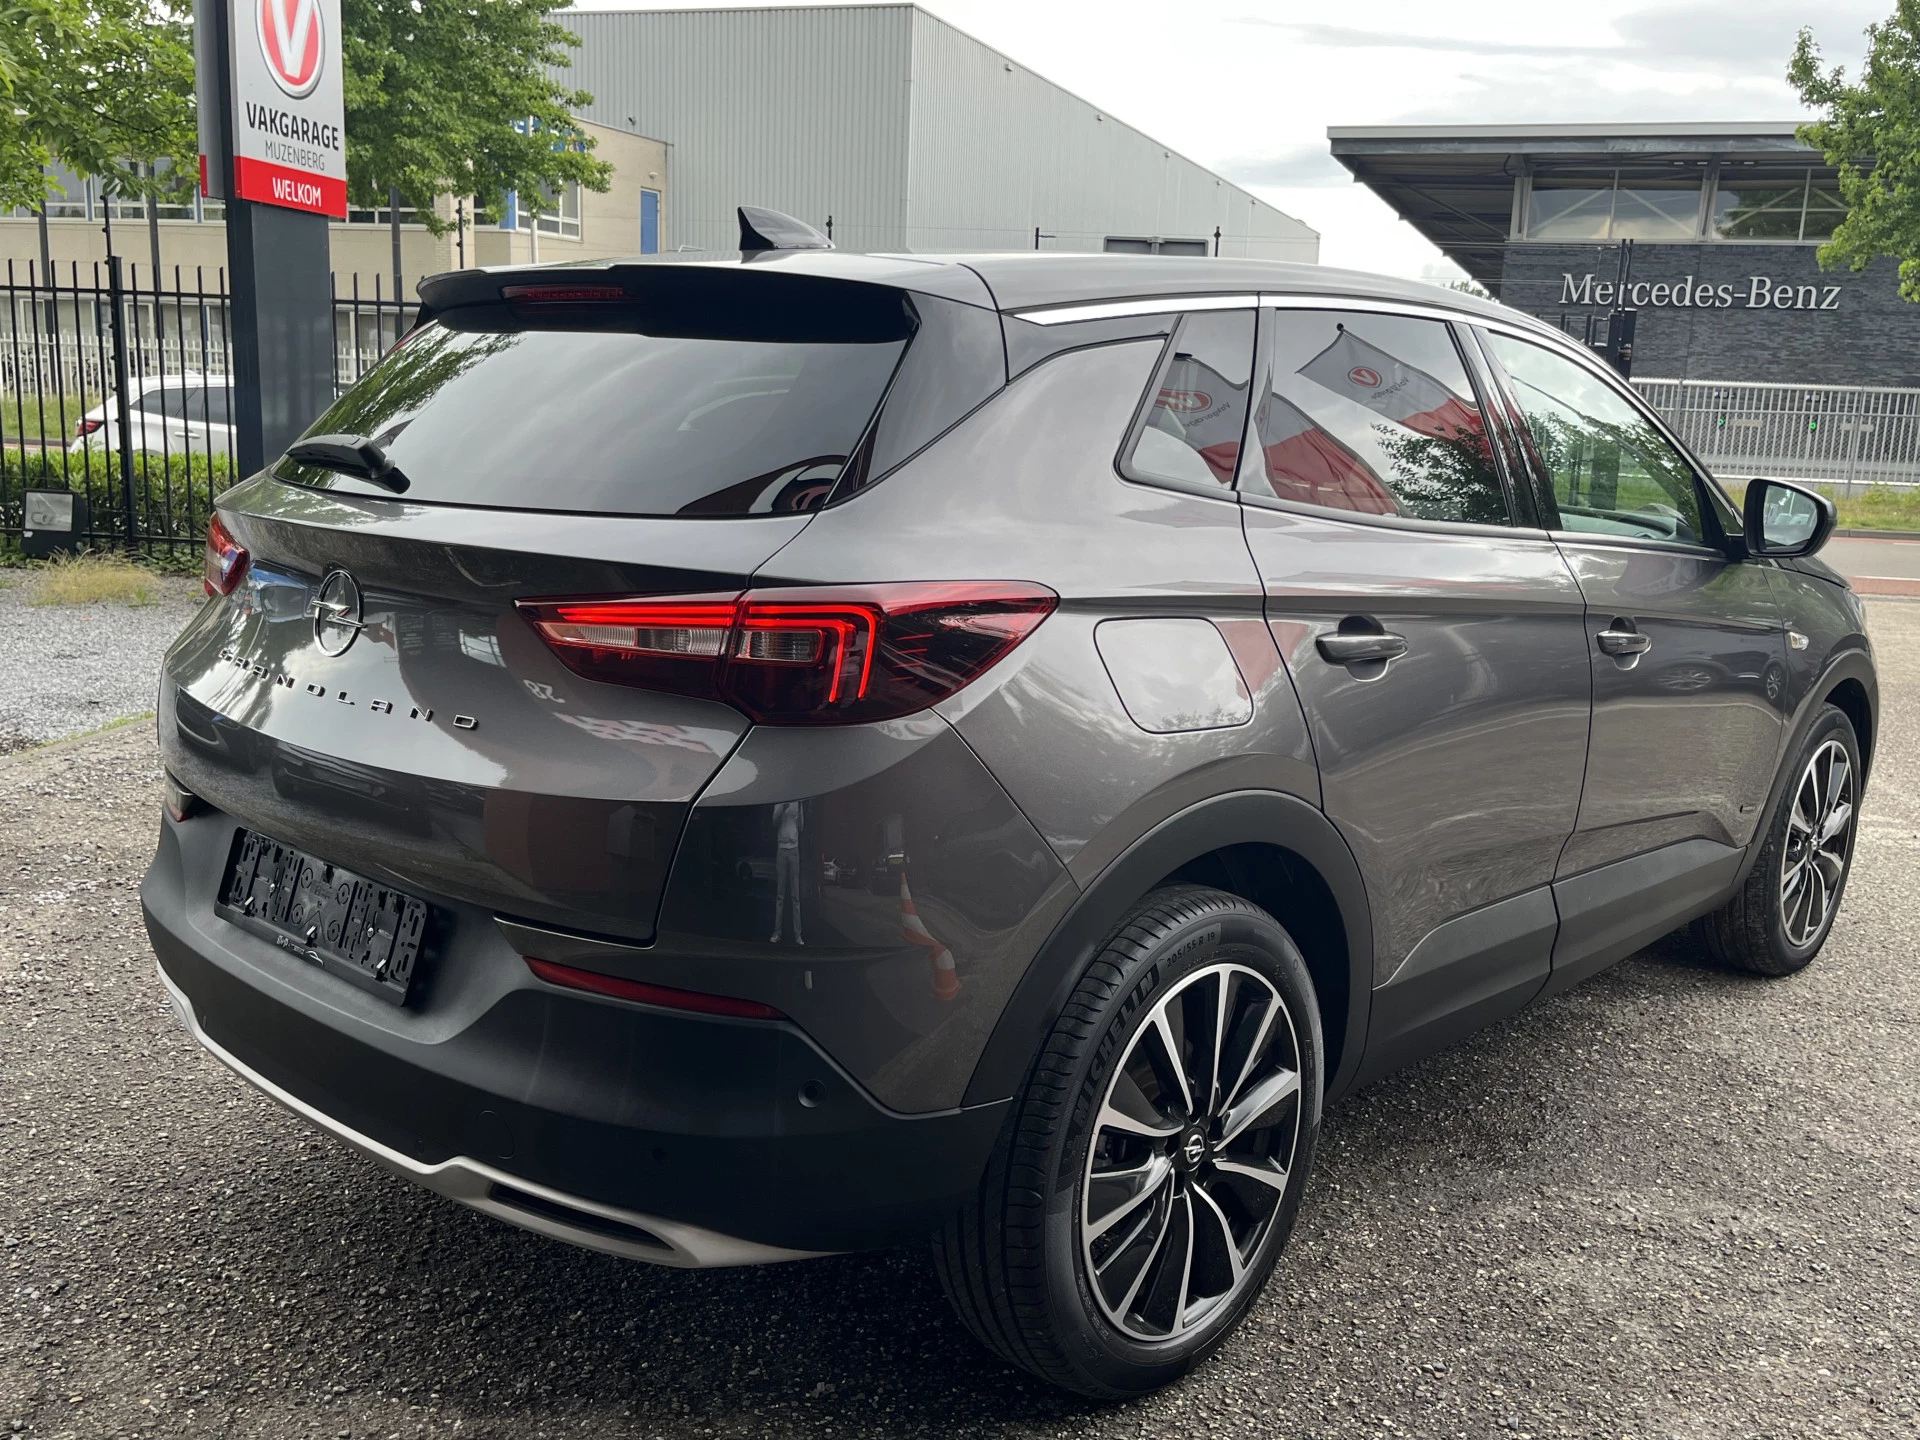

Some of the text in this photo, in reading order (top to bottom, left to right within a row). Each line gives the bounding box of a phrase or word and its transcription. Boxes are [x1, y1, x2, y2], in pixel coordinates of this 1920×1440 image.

[246, 102, 339, 151] VAKGARAGE
[265, 140, 325, 171] MUZENBERG
[272, 177, 322, 207] WELKOM
[1558, 273, 1842, 310] Mercedes-Benz
[1167, 938, 1196, 968] 205/55
[1198, 935, 1205, 946] R
[1207, 931, 1216, 941] 19
[1073, 971, 1155, 1124] MICHELIN
